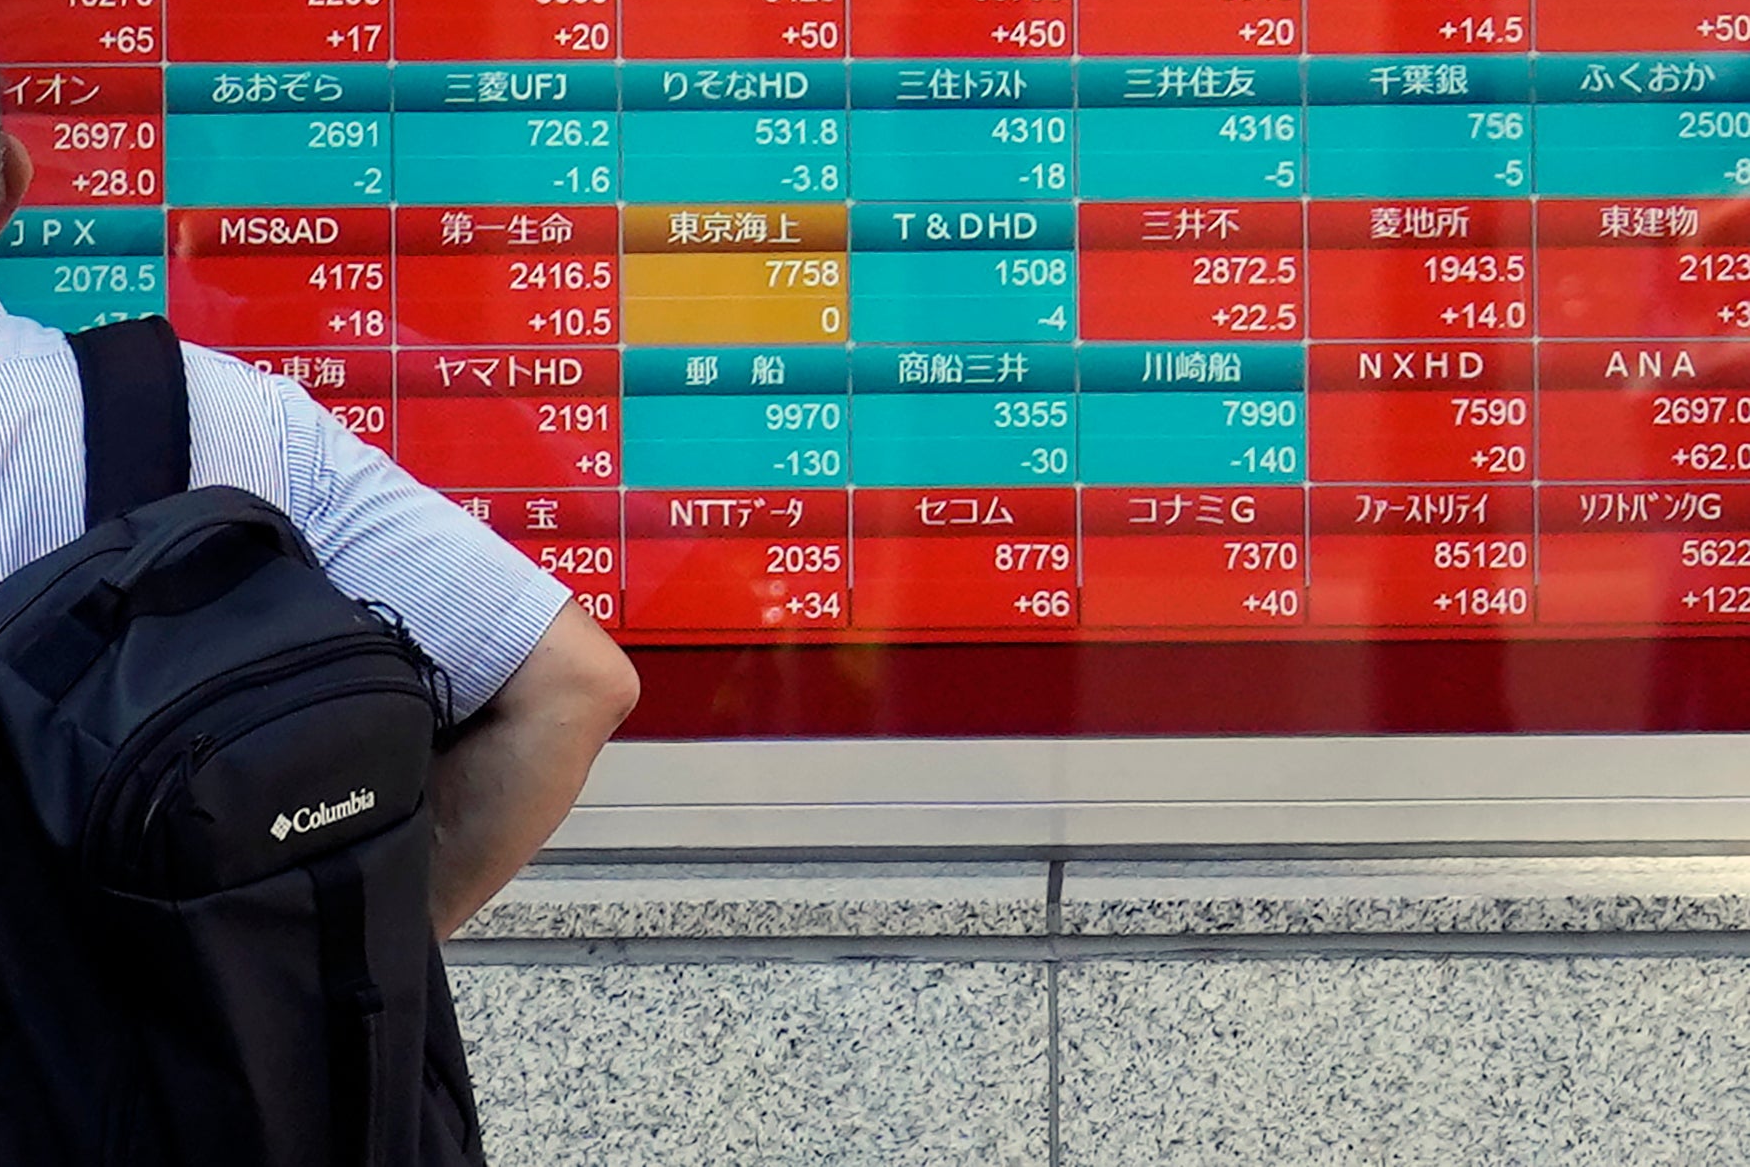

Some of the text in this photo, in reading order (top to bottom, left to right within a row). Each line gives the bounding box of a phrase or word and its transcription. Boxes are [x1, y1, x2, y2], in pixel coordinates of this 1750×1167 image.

[990, 18, 1067, 49] +450
[1122, 65, 1257, 99] 三井住友
[526, 118, 611, 148] 726.2
[1218, 113, 1296, 143] 4316
[552, 165, 612, 194] -1.6
[1263, 159, 1296, 189] -5
[219, 216, 340, 246] MS&AD
[666, 209, 802, 245] 東京海上
[307, 262, 384, 291] 4175
[764, 259, 841, 289] 7758
[327, 308, 385, 338] +18
[820, 305, 841, 334] 0
[897, 350, 1030, 385] 商船三井
[537, 403, 608, 433] 2191
[993, 400, 1069, 429] 3355
[574, 449, 614, 479] +8
[1019, 446, 1069, 475] -30
[1222, 541, 1299, 571] 7370
[1241, 588, 1299, 617] +40
[292, 788, 375, 833] Columbia
